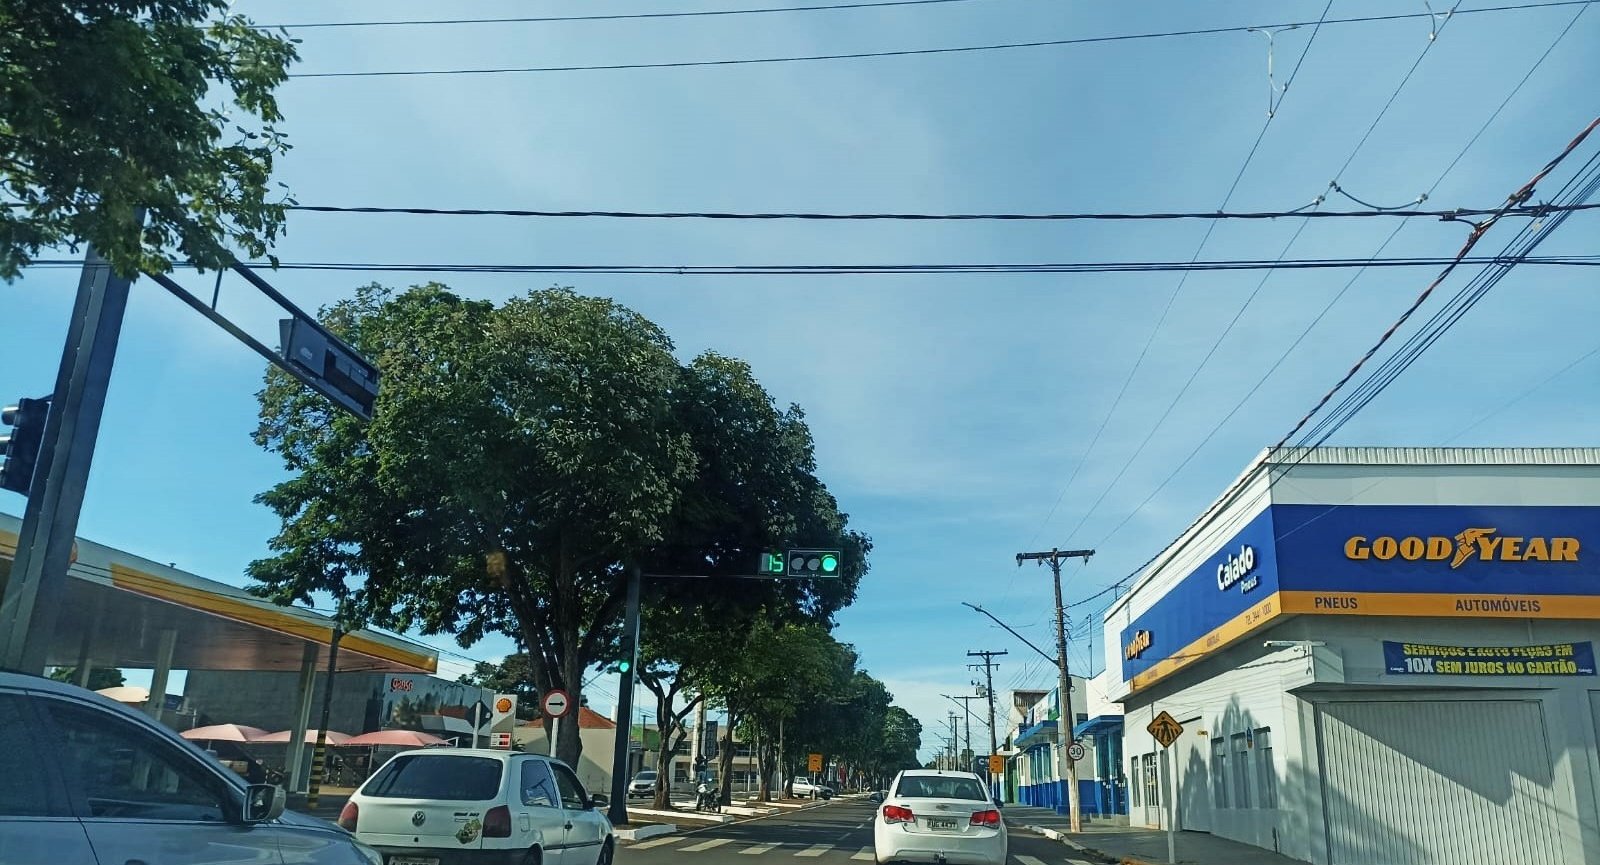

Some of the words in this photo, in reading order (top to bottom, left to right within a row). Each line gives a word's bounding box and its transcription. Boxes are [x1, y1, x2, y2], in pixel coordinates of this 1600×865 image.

[769, 553, 784, 572] 15
[1217, 544, 1254, 591] Caiado
[1315, 596, 1358, 609] PNEUS
[1455, 598, 1541, 612] AUTOMÓVEIS
[1554, 644, 1573, 656] EM
[1404, 657, 1434, 673] 10X
[1435, 661, 1462, 674] SEM
[1464, 661, 1505, 674] JUROS
[1506, 661, 1525, 674] NO
[1526, 659, 1577, 674] CARTÃO
[1070, 747, 1081, 756] 30
